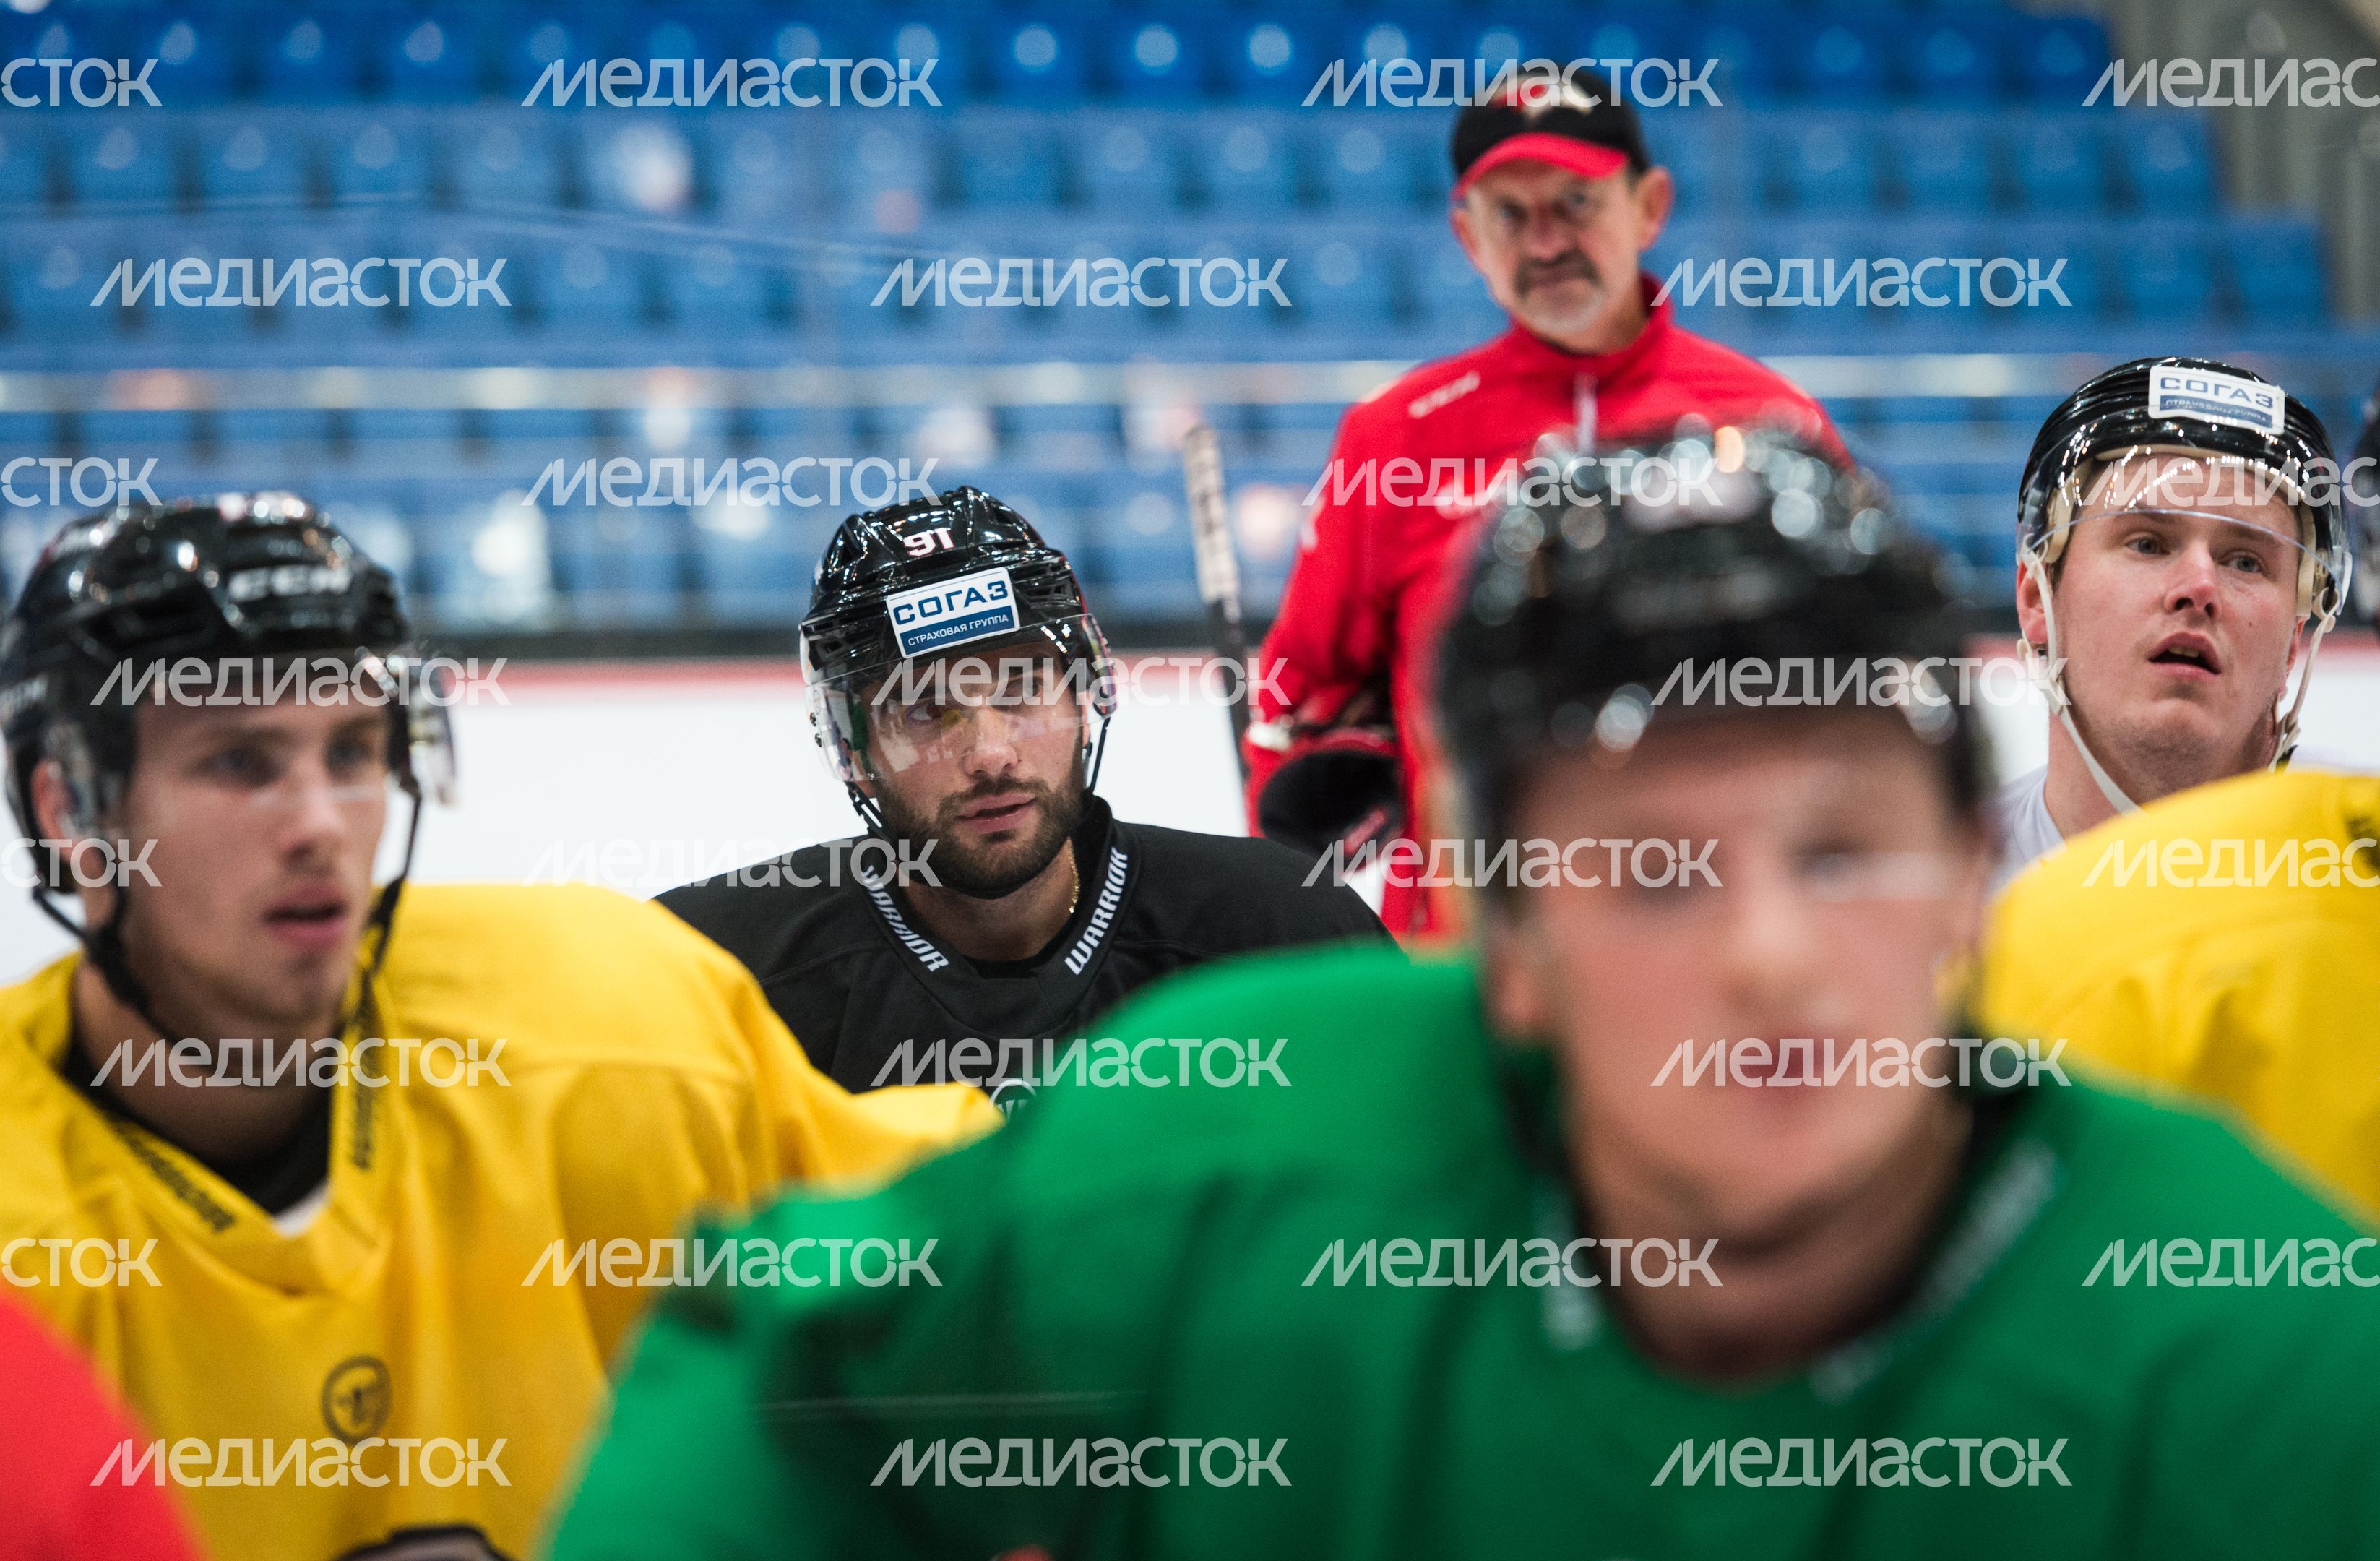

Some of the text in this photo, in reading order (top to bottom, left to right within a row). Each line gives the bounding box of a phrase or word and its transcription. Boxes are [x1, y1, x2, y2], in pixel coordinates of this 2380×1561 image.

[2160, 377, 2273, 408] СОГАЗ
[902, 527, 955, 557] 91
[893, 580, 1009, 626] СОГАЗ
[907, 614, 1009, 646] СТРАХОВАЯ ГРУППА
[1063, 846, 1128, 976] WARRIOR
